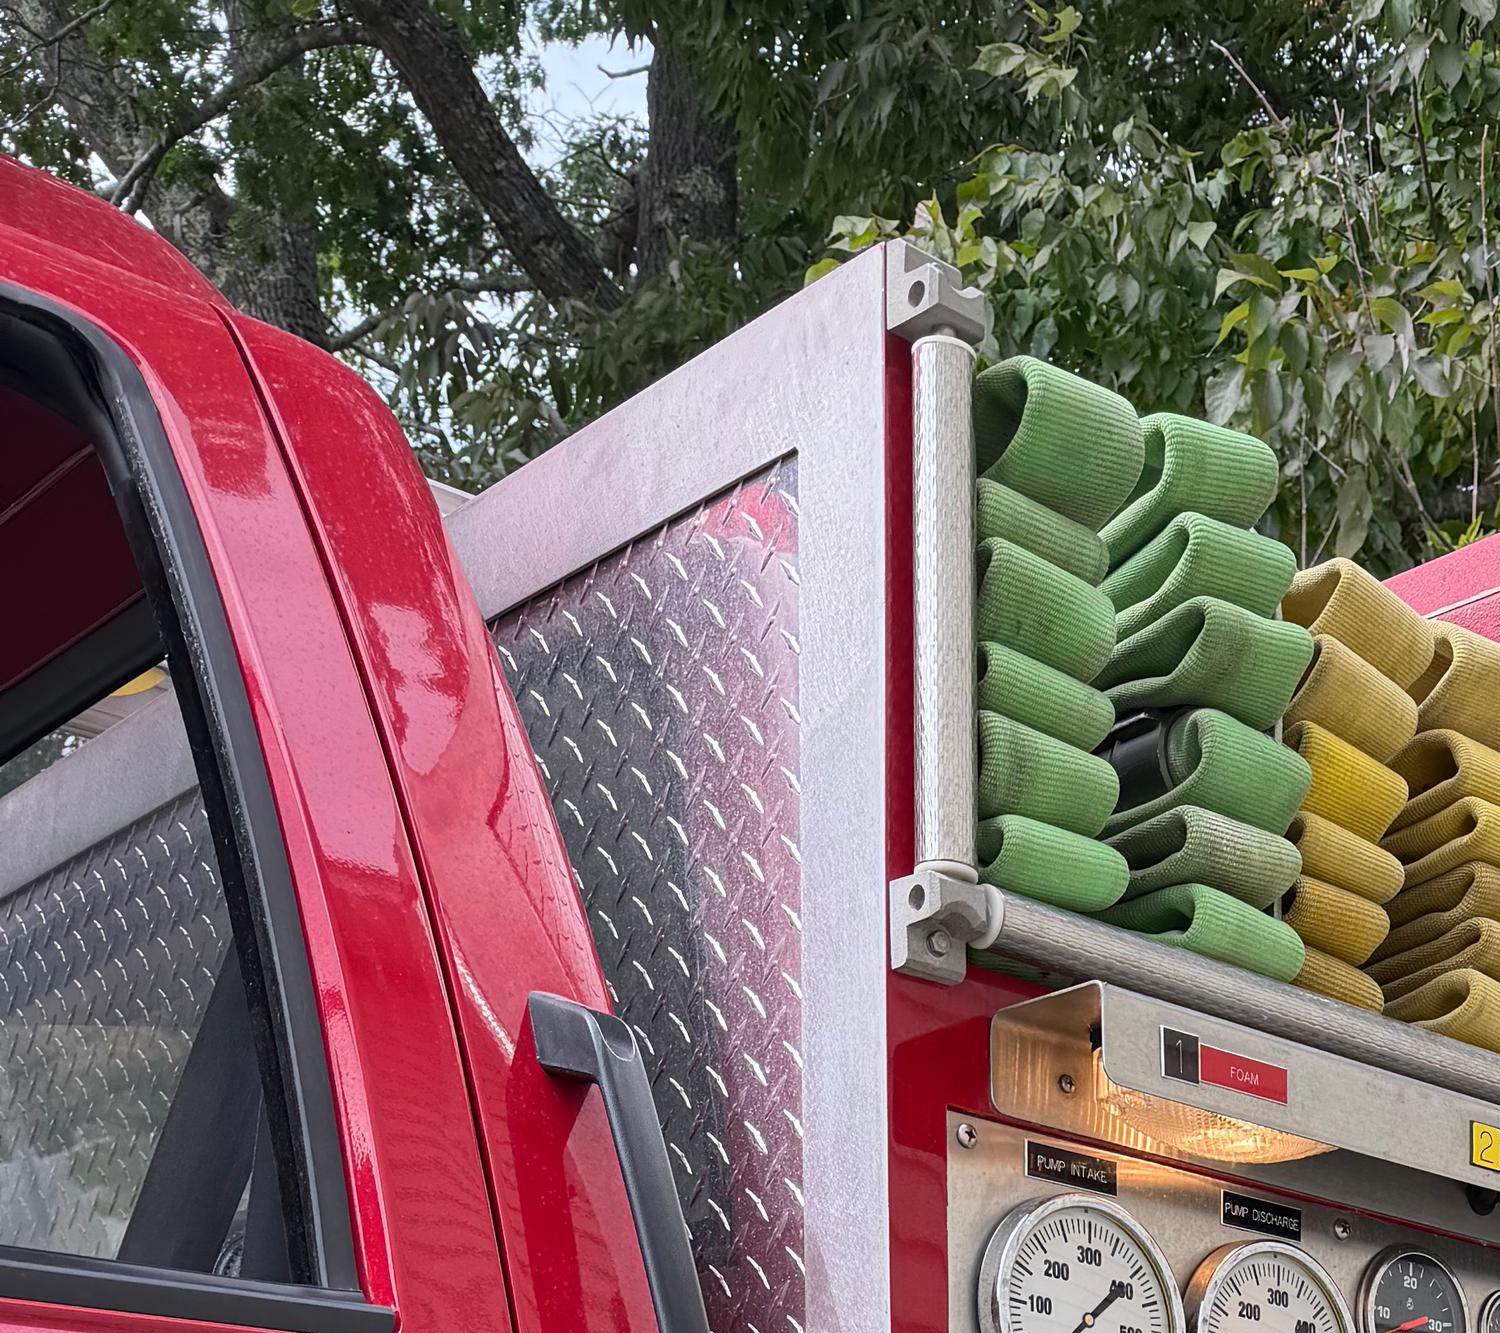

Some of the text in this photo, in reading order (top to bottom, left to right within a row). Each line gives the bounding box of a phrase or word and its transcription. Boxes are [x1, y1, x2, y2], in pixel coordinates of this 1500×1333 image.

[1176, 1039, 1182, 1074] 1
[1231, 1066, 1259, 1085] FOAM
[1479, 1131, 1494, 1164] 2
[1037, 1155, 1107, 1184] PUMP INTAKE
[1225, 1202, 1299, 1232] PUMP DISCHARGE
[1077, 1246, 1101, 1266] 300
[1044, 1260, 1069, 1280] 200
[1110, 1280, 1133, 1299] 40
[1404, 1276, 1417, 1289] 20
[1029, 1295, 1052, 1315] 100
[1267, 1288, 1288, 1308] 300
[1239, 1301, 1260, 1321] 200
[1377, 1306, 1390, 1318] 10
[1428, 1319, 1442, 1332] 30
